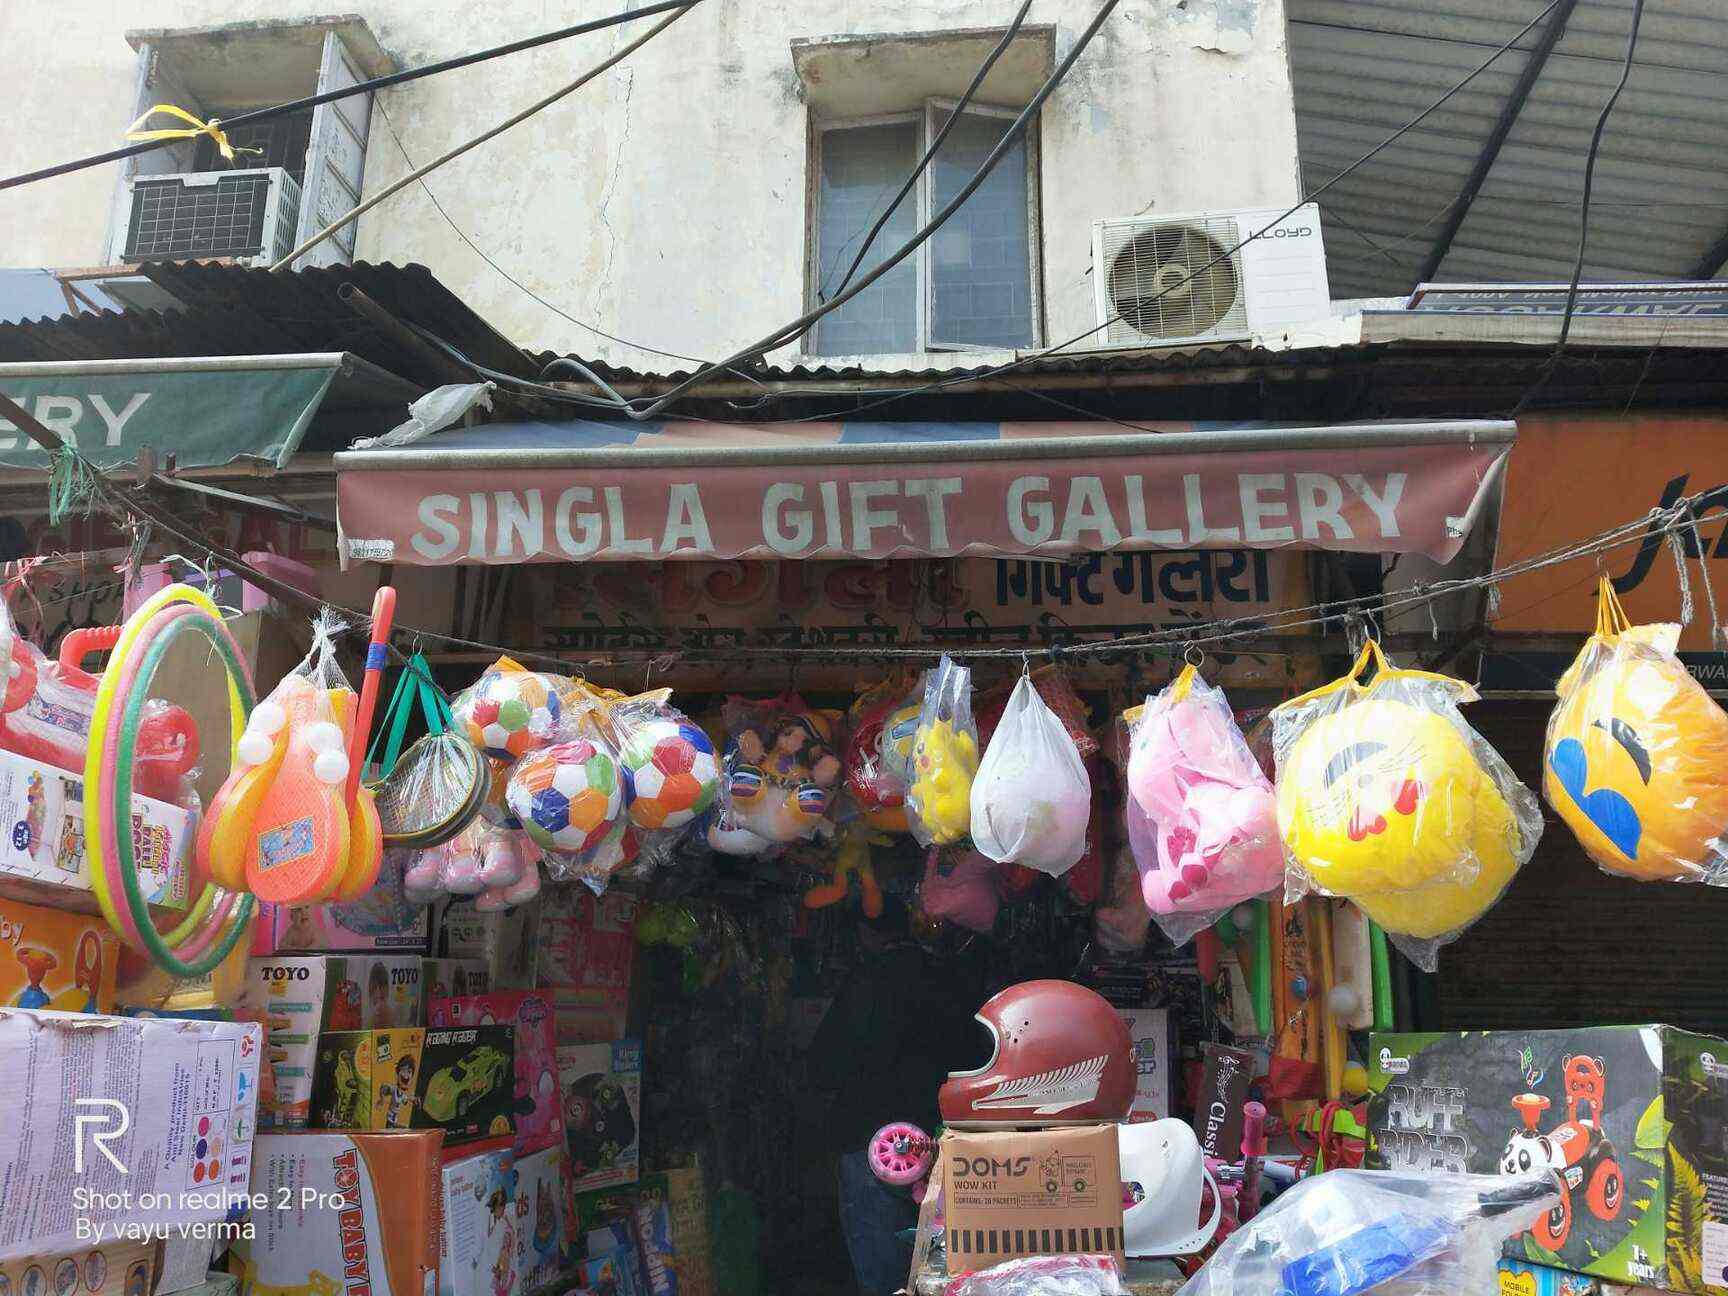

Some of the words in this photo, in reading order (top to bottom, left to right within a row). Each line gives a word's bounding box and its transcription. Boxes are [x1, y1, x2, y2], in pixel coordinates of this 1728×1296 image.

[1249, 226, 1312, 240] LLOYD
[411, 482, 716, 560] SINGLA
[762, 476, 962, 553] GIFT
[1006, 472, 1408, 546] GALLERY
[262, 967, 310, 981] TOYO
[391, 967, 418, 985] TOYO
[952, 1157, 1031, 1177] DOMS
[954, 1180, 979, 1191] WOW
[981, 1180, 998, 1191] KIT
[1626, 1260, 1656, 1279] years
